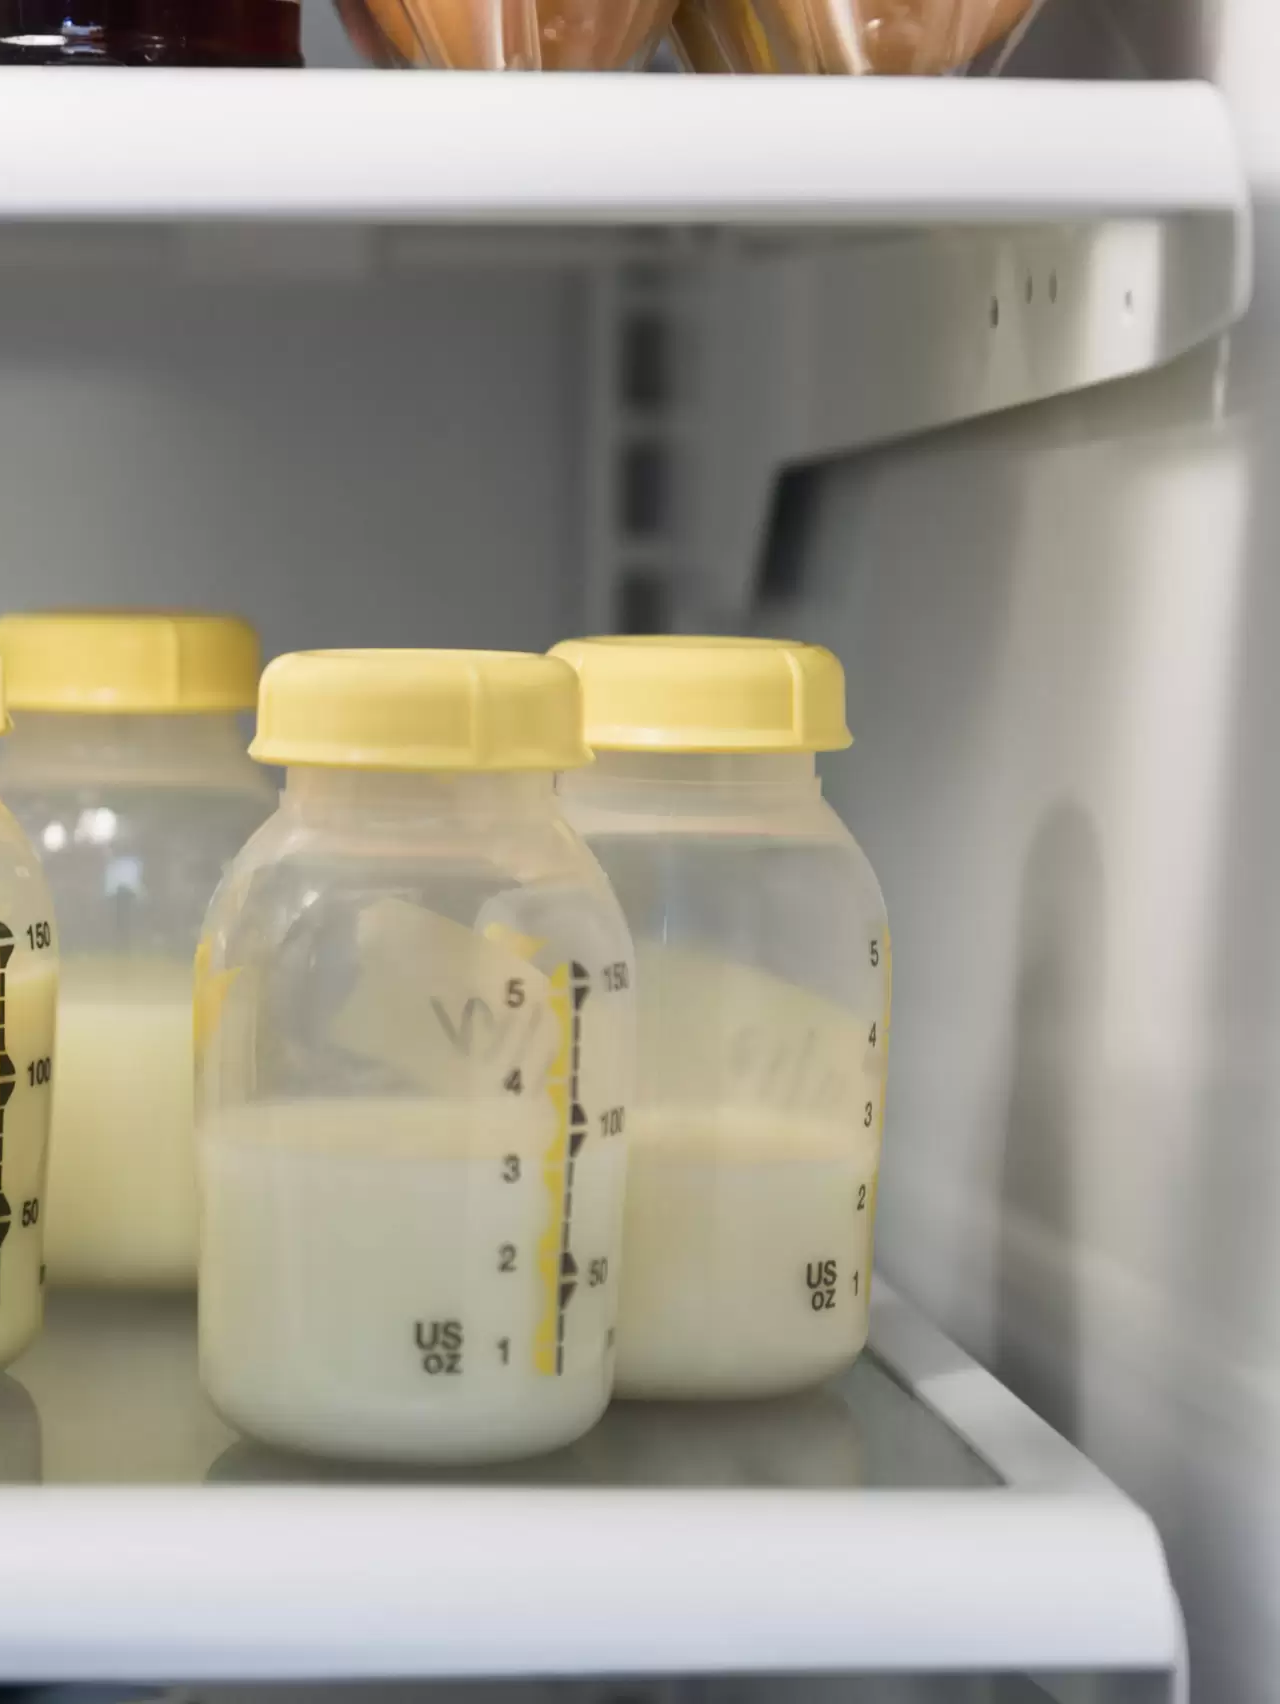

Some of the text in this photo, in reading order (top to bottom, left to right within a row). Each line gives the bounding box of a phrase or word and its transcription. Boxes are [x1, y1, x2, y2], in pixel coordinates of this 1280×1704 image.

[26, 921, 51, 951] 150
[870, 939, 879, 967] 5
[506, 978, 525, 1009] 5
[868, 1020, 877, 1048] 4
[27, 1056, 52, 1087] 100
[504, 1067, 523, 1095] 4
[863, 1101, 873, 1128] 3
[502, 1154, 521, 1184] 3
[856, 1183, 866, 1211] 2
[21, 1198, 39, 1229] 50
[498, 1244, 517, 1274] 2
[588, 1256, 609, 1288] 50
[806, 1260, 837, 1289] US
[852, 1269, 859, 1296] 1
[811, 1288, 836, 1311] oz
[415, 1321, 463, 1351] US
[423, 1352, 462, 1376] oz
[497, 1337, 510, 1366] 1
